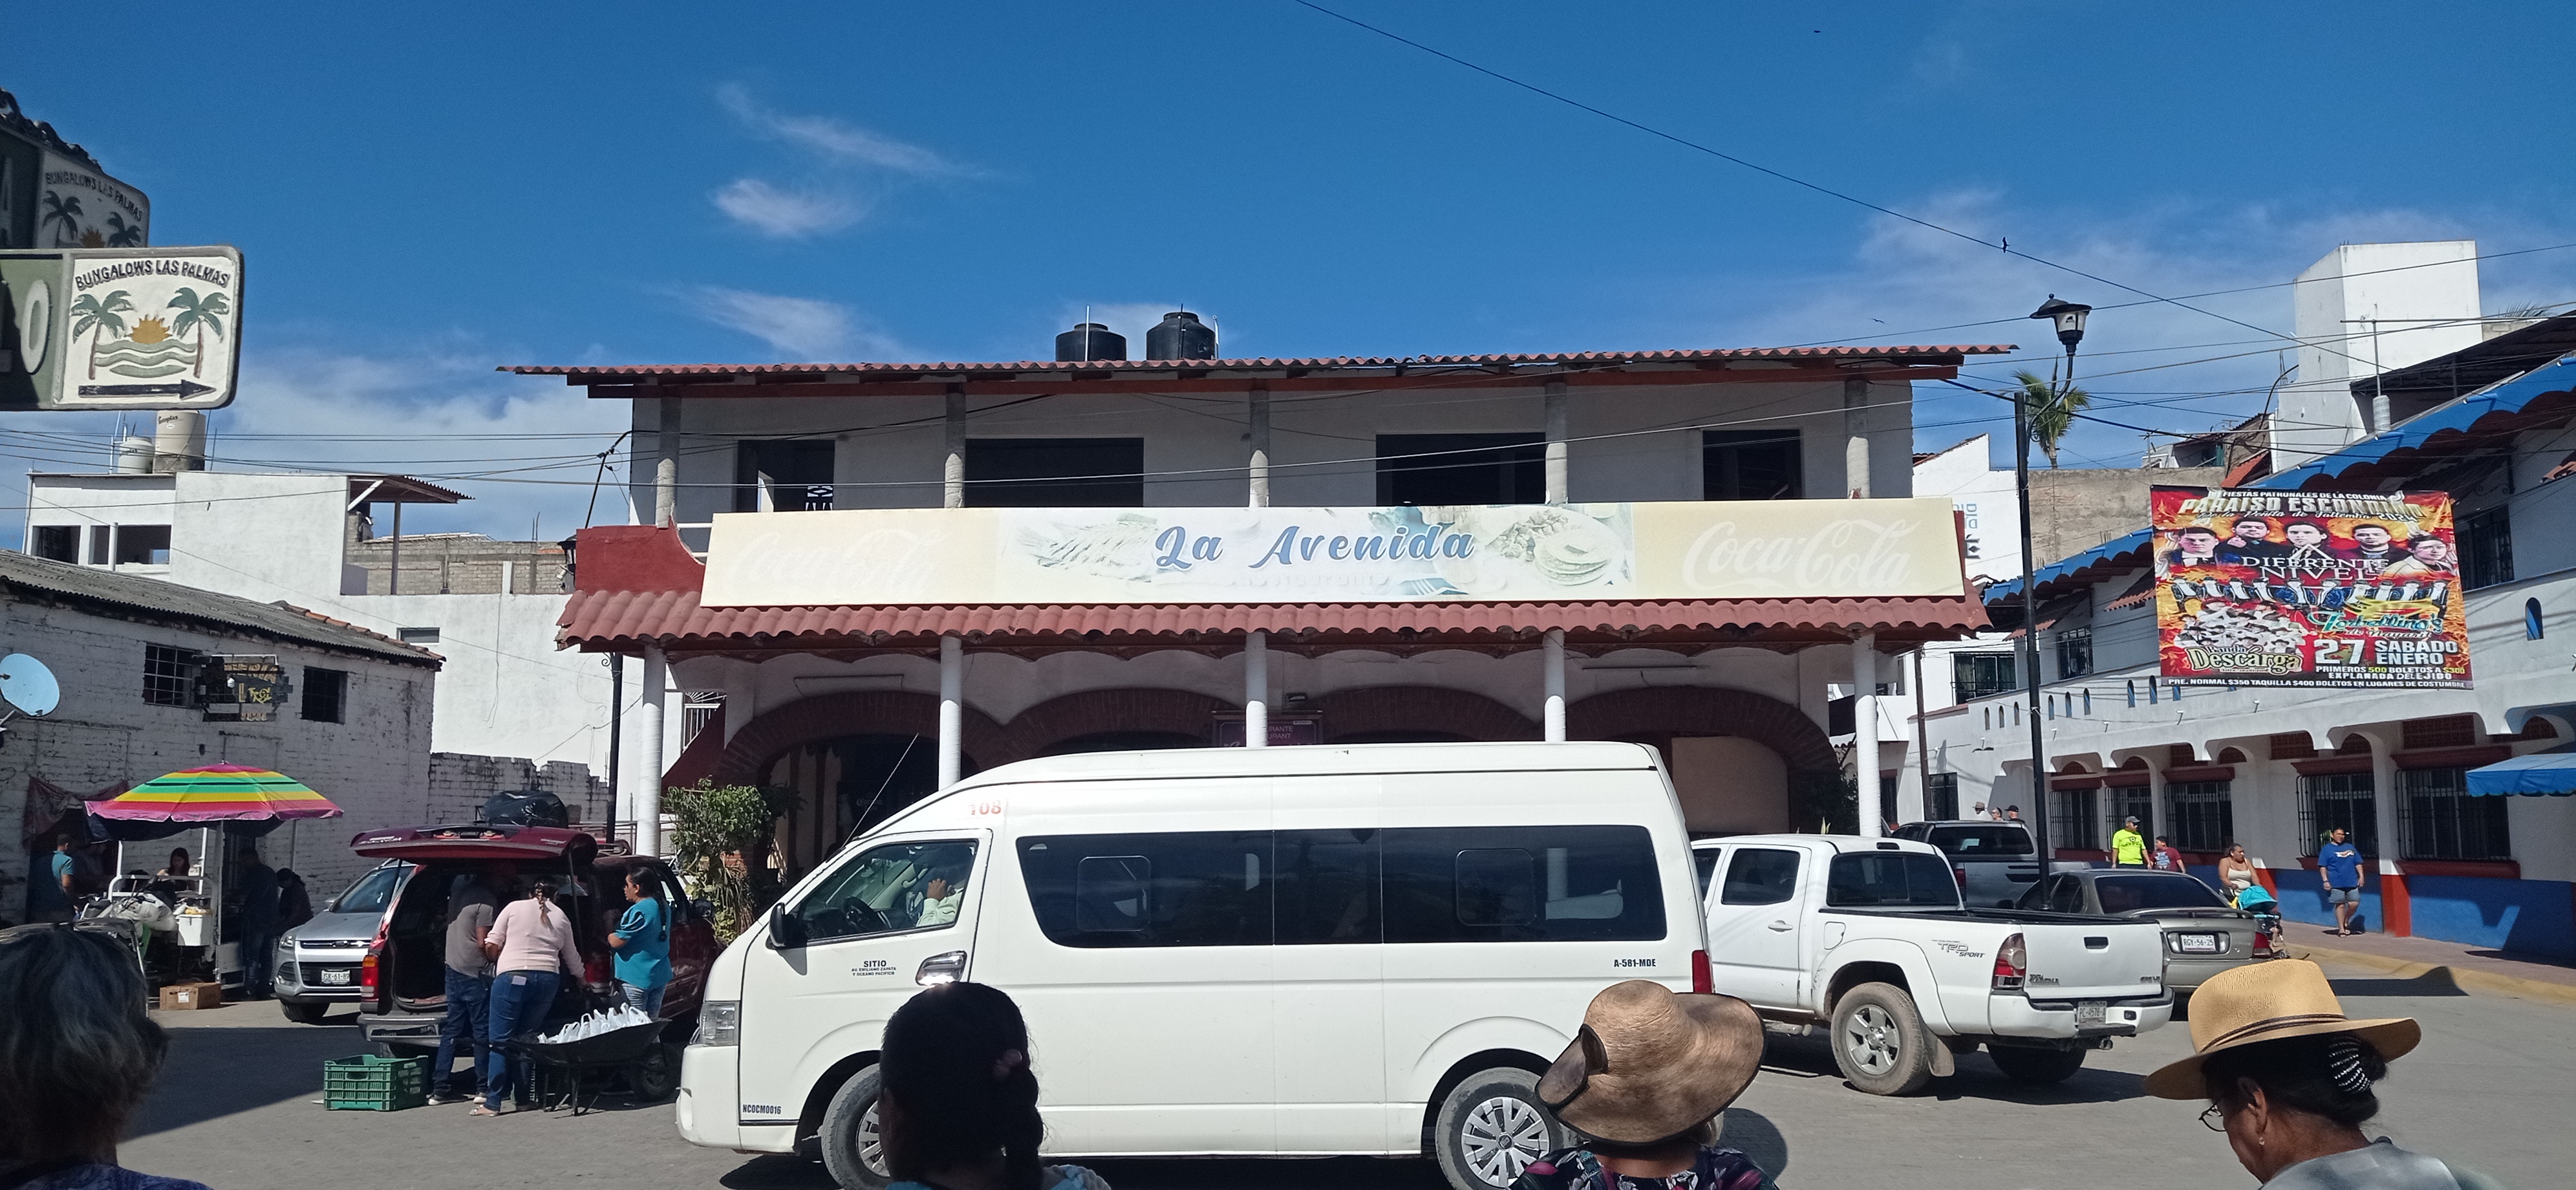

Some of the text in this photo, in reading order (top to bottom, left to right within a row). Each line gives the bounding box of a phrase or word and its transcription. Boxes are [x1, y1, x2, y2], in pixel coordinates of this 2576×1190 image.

[46, 171, 96, 190] BUNGALOWS
[114, 190, 142, 221] PALMAS
[75, 259, 230, 290] BUNGALOWS LAS PALMAS
[2178, 497, 2426, 517] PARAISO ESCONDIDO
[2376, 512, 2420, 522] 2024
[1154, 521, 1476, 571] La Avenida
[2242, 556, 2390, 568] DIFERENTE
[2259, 566, 2377, 581] NIVEL
[2313, 639, 2365, 665] 27
[2375, 640, 2458, 653] SABADO
[2377, 653, 2444, 665] ENERO
[1938, 942, 1969, 953] TRD
[1614, 958, 1657, 968] A-581-MDE
